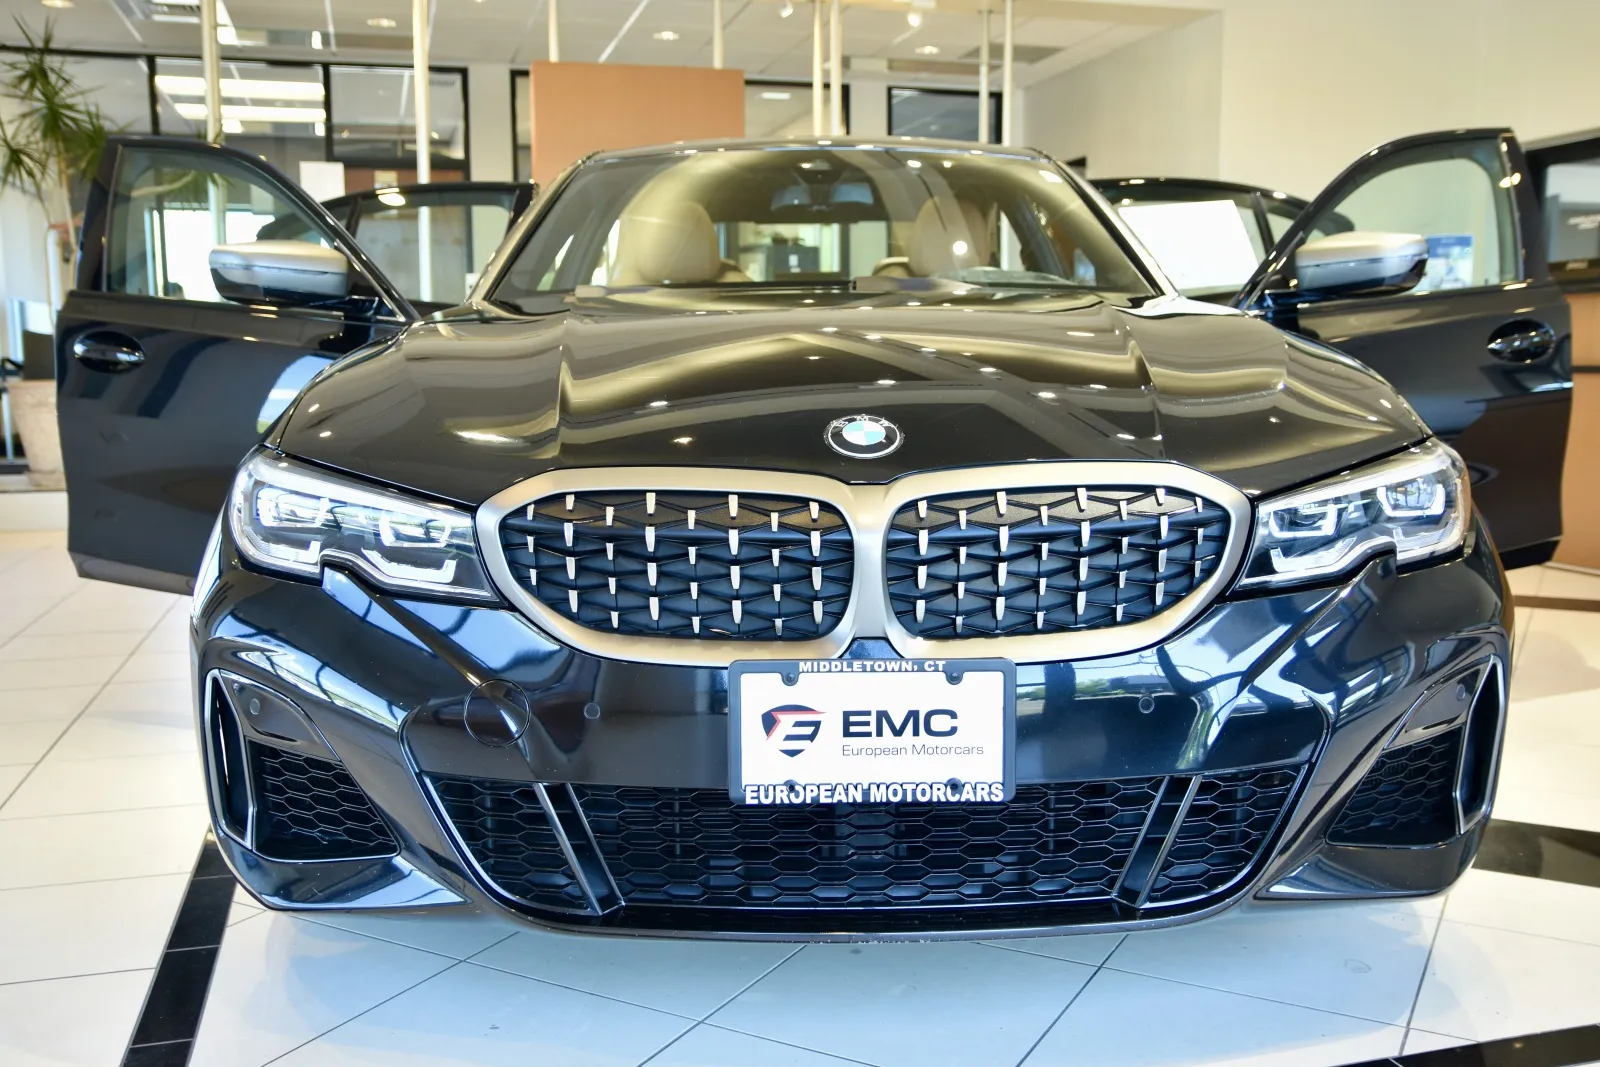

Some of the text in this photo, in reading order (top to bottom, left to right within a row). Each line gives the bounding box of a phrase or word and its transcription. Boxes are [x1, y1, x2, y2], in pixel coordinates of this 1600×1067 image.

[799, 661, 946, 672] MIDDLETOWN, CT
[842, 709, 959, 738] EMC
[842, 743, 984, 758] European Motorcars
[745, 783, 1004, 804] EUROPEAN MOTORCARS
